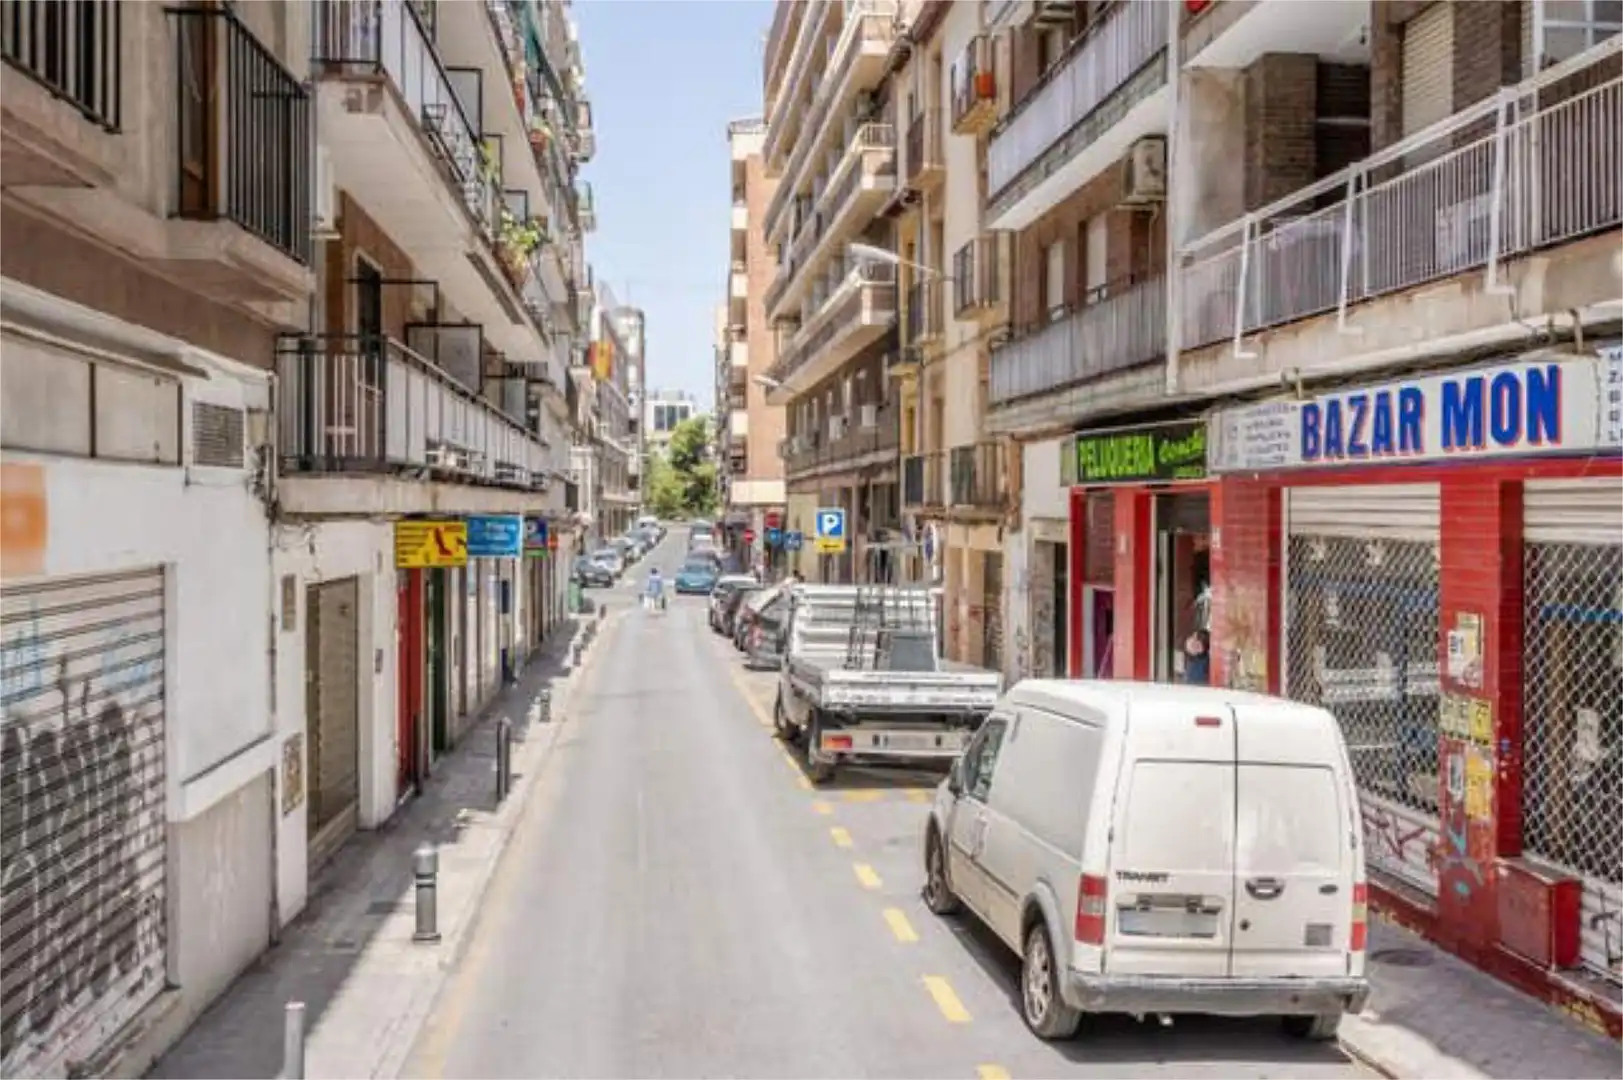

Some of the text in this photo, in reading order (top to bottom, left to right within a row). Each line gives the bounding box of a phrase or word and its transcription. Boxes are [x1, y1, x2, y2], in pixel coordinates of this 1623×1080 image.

[1301, 386, 1426, 461] BAZAR
[1440, 364, 1563, 453] MON
[822, 512, 840, 537] P
